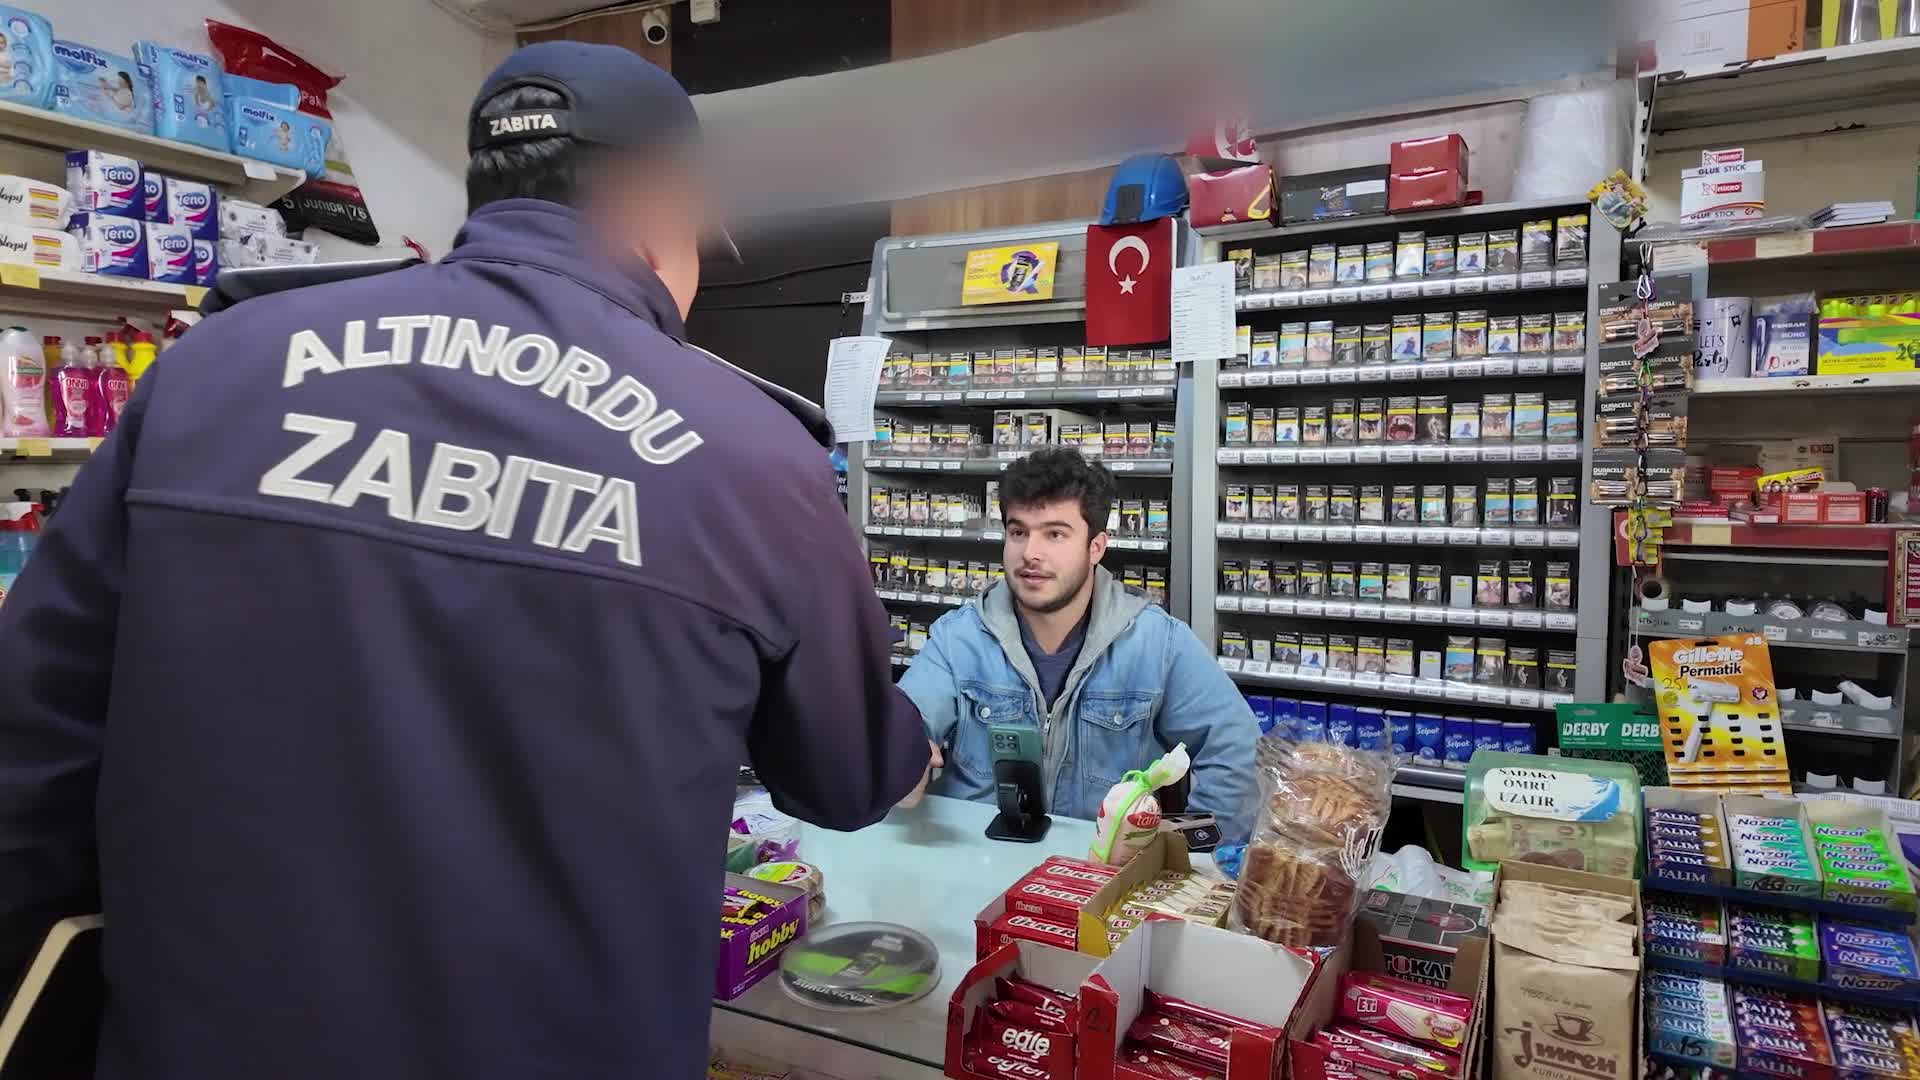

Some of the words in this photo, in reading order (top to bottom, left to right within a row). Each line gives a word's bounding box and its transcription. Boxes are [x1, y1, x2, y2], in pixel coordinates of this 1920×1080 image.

[54, 45, 107, 68] molfix
[243, 107, 275, 121] molfix
[490, 113, 557, 136] ZABITA
[103, 166, 134, 182] Teno
[1698, 167, 1720, 175] GLUE
[177, 194, 206, 208] Teno
[350, 205, 368, 220] 76
[103, 226, 135, 241] Teno
[159, 236, 189, 251] Teno
[1699, 335, 1725, 349] LET'S
[1600, 360, 1632, 369] DURACELL
[1692, 349, 1729, 374] Party
[282, 315, 704, 464] ALTINORDU
[1601, 402, 1632, 410] DURACELL
[259, 412, 643, 567] ZABITA
[1673, 646, 1744, 664] Gillette
[1680, 662, 1742, 677] Permatik
[1416, 726, 1440, 737] Selpak
[1562, 722, 1609, 737] DERBY
[1621, 722, 1661, 738] DERB
[1446, 738, 1471, 750] Selpak
[1475, 741, 1500, 752] Selpak
[1499, 768, 1556, 780] SADAKA
[1503, 779, 1551, 792] ÖMRÜ
[1500, 791, 1555, 807] UZATIR
[1655, 811, 1697, 822] FALIM
[1737, 818, 1784, 827] Nazar
[1655, 826, 1697, 837] FALIM
[1740, 833, 1788, 842] Nazar
[1816, 827, 1864, 837] Nazar
[1657, 839, 1700, 850] FALIM
[1821, 843, 1872, 852] Nazar
[1659, 854, 1703, 866] FALIM
[1747, 858, 1796, 868] Nazar
[1825, 851, 1876, 862] Nazar
[1832, 861, 1885, 872] Nazar
[1658, 868, 1706, 883] FALIM
[1022, 883, 1091, 905] ÜLKER
[1836, 893, 1890, 905] Nazar
[1008, 915, 1076, 939] ÜLKER
[747, 918, 800, 965] hobby
[1738, 935, 1788, 950] FALIM
[1836, 932, 1891, 947] Nazar
[1650, 942, 1700, 959] FALIM
[1736, 956, 1789, 973] FALIM
[1840, 950, 1896, 967] Nazar
[1840, 975, 1897, 990] Nazar
[1745, 1014, 1796, 1032] FALIM
[1753, 1034, 1807, 1052] FALIM
[1841, 1029, 1896, 1048] FALIM
[1747, 1056, 1803, 1077] FALIM
[1848, 1052, 1901, 1071] FALIM
